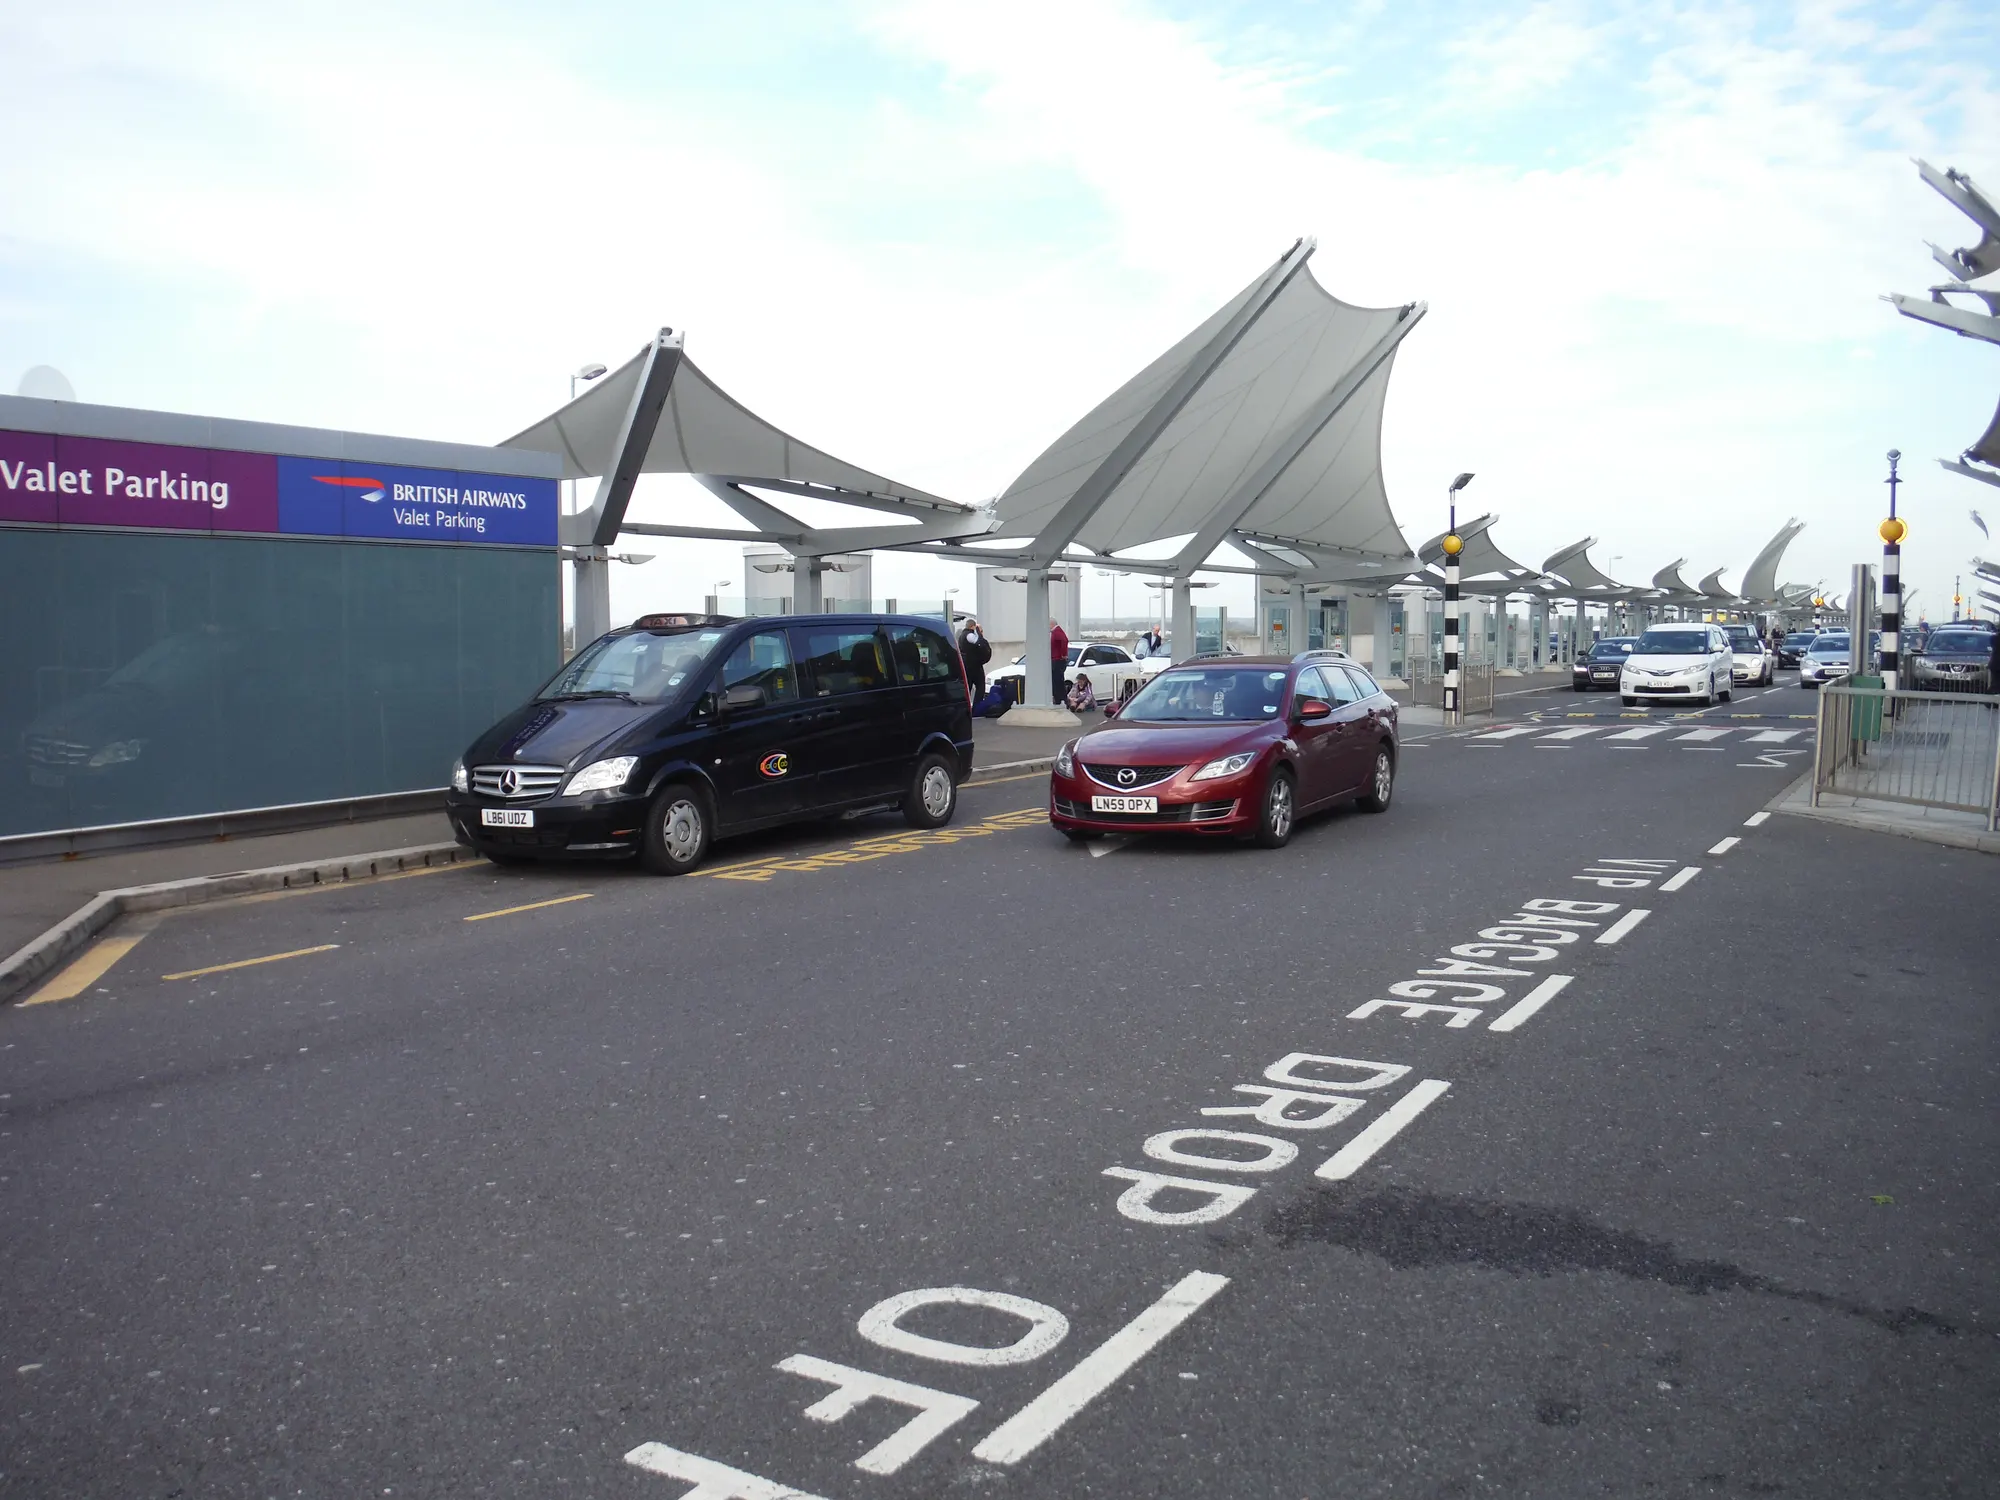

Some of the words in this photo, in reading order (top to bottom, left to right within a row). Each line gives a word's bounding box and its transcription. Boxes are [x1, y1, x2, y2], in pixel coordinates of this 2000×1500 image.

[0, 460, 93, 494] Valet
[105, 467, 229, 509] Parking
[393, 483, 458, 505] BRITISH
[461, 489, 526, 510] AIRWAYS
[393, 507, 430, 526] Valet
[436, 510, 485, 532] Parking
[649, 617, 677, 626] TAXI
[1095, 798, 1125, 810] LN59
[1128, 799, 1152, 811] OPX
[486, 812, 506, 824] LB61
[508, 812, 527, 825] UDZ
[1572, 858, 1677, 888] VIP
[1346, 898, 1621, 1028] BAGGAGE
[1100, 1052, 1413, 1225] DROP
